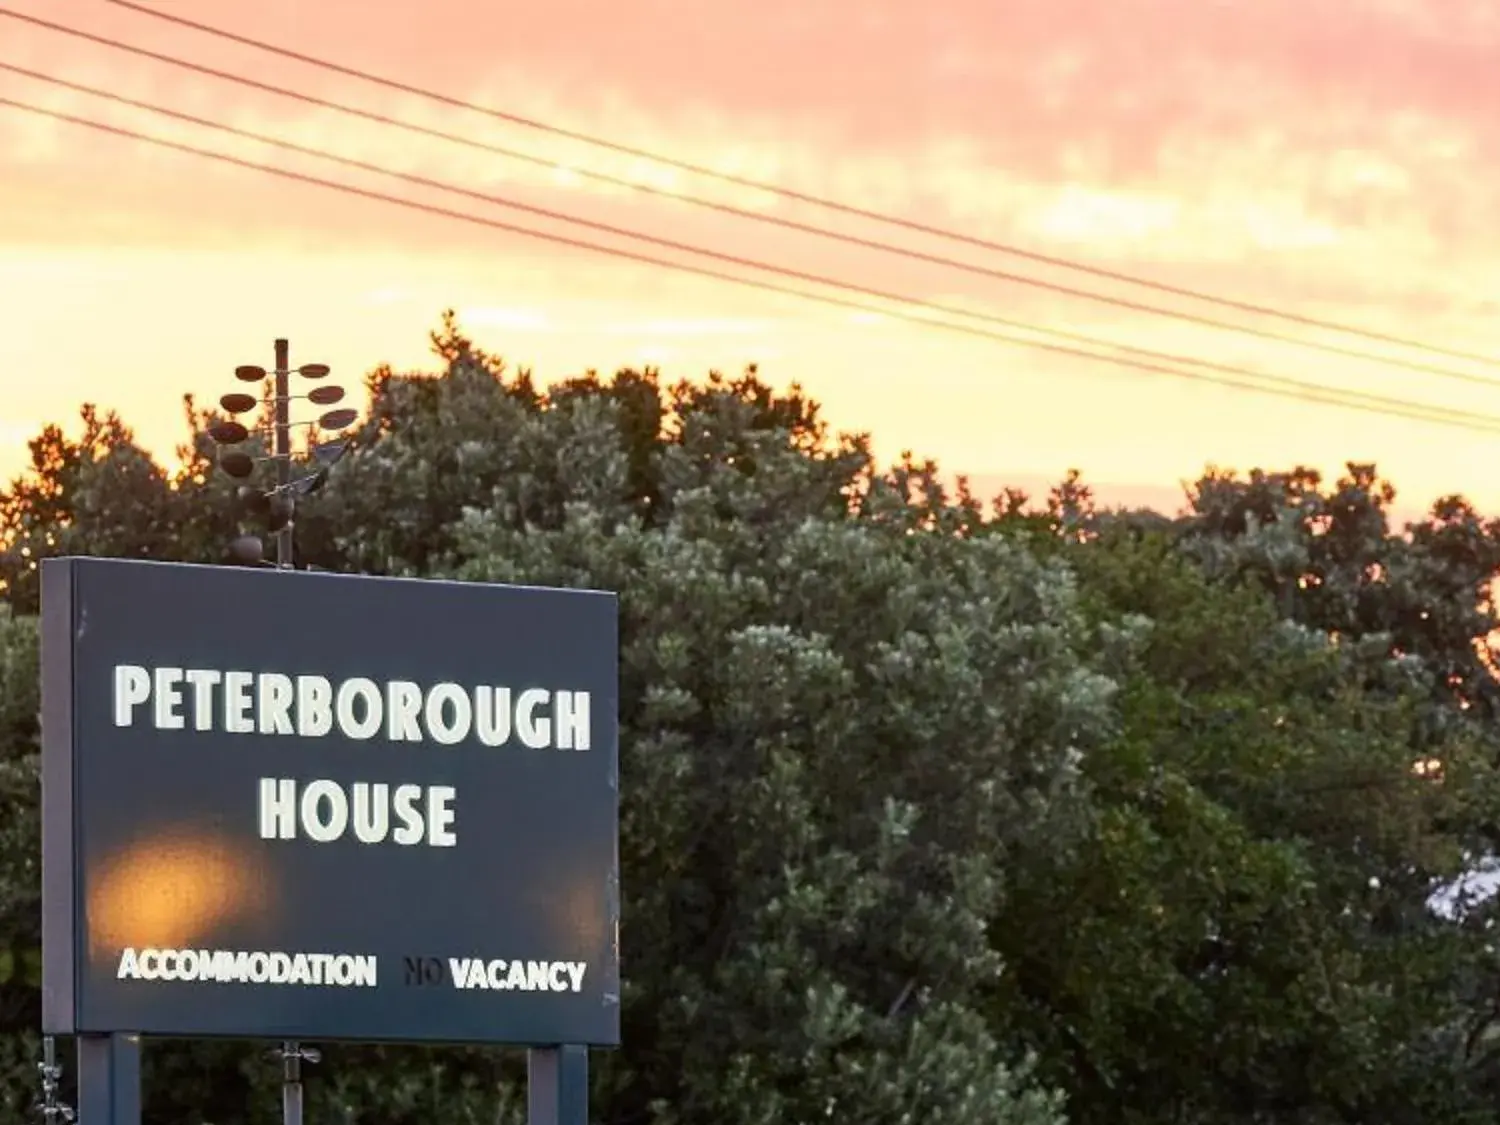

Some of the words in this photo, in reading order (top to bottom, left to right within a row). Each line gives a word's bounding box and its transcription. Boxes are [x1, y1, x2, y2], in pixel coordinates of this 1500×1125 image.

[115, 665, 590, 750] PETERBOROUGH
[260, 778, 456, 846] HOUSE
[118, 948, 376, 986] ACCOMMODATION
[404, 957, 444, 986] NO
[449, 957, 587, 992] VACANCY
